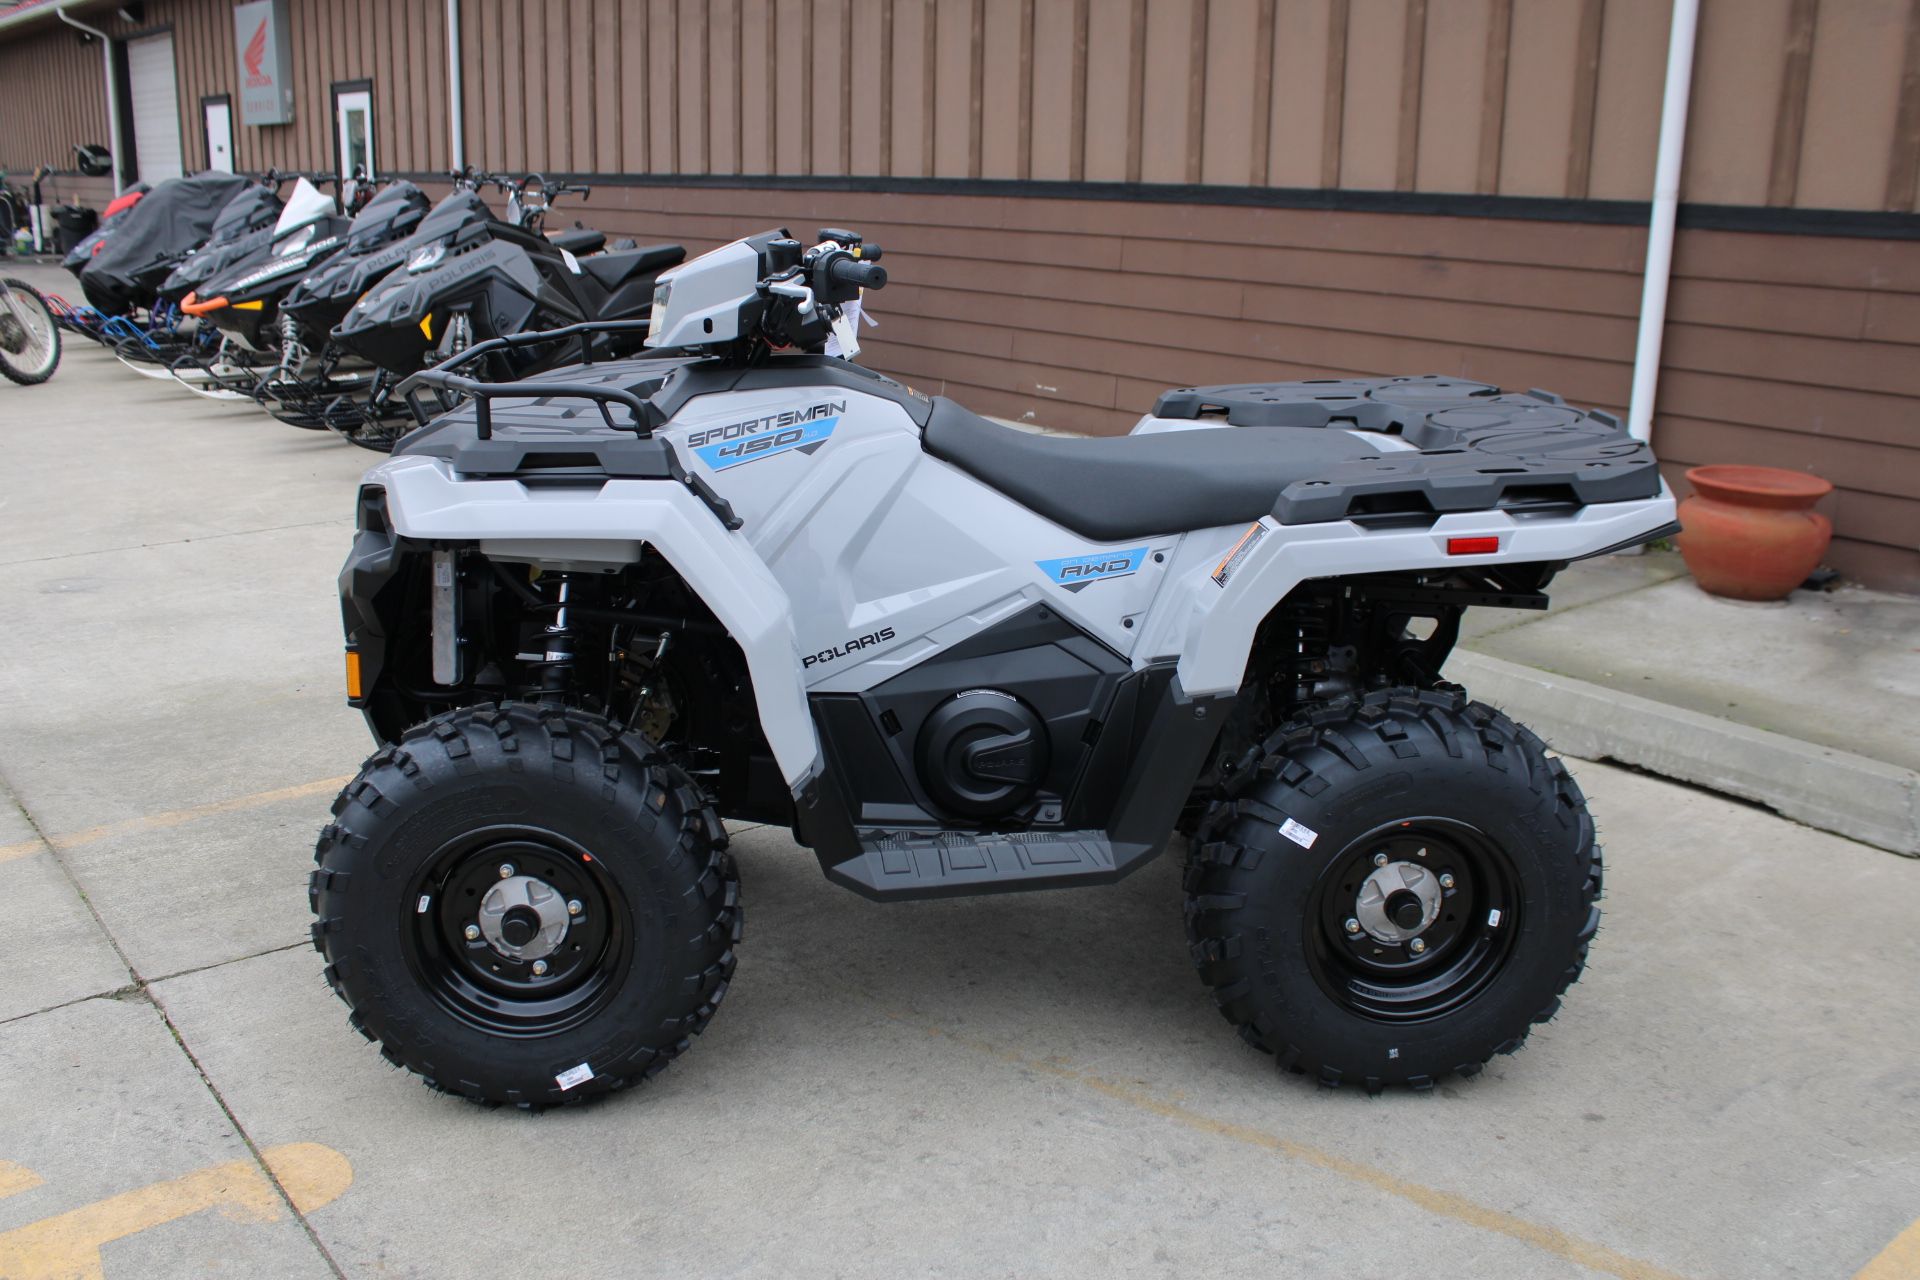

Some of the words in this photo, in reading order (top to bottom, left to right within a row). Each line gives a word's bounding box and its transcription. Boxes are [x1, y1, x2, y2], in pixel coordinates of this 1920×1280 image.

[245, 75, 273, 88] HONDA
[237, 256, 305, 287] POLARIS
[429, 248, 497, 290] POLARIS
[687, 400, 847, 449] SPORTSMAN
[718, 428, 803, 457] 450
[1060, 558, 1131, 579] AWD
[801, 626, 896, 669] POLARIS
